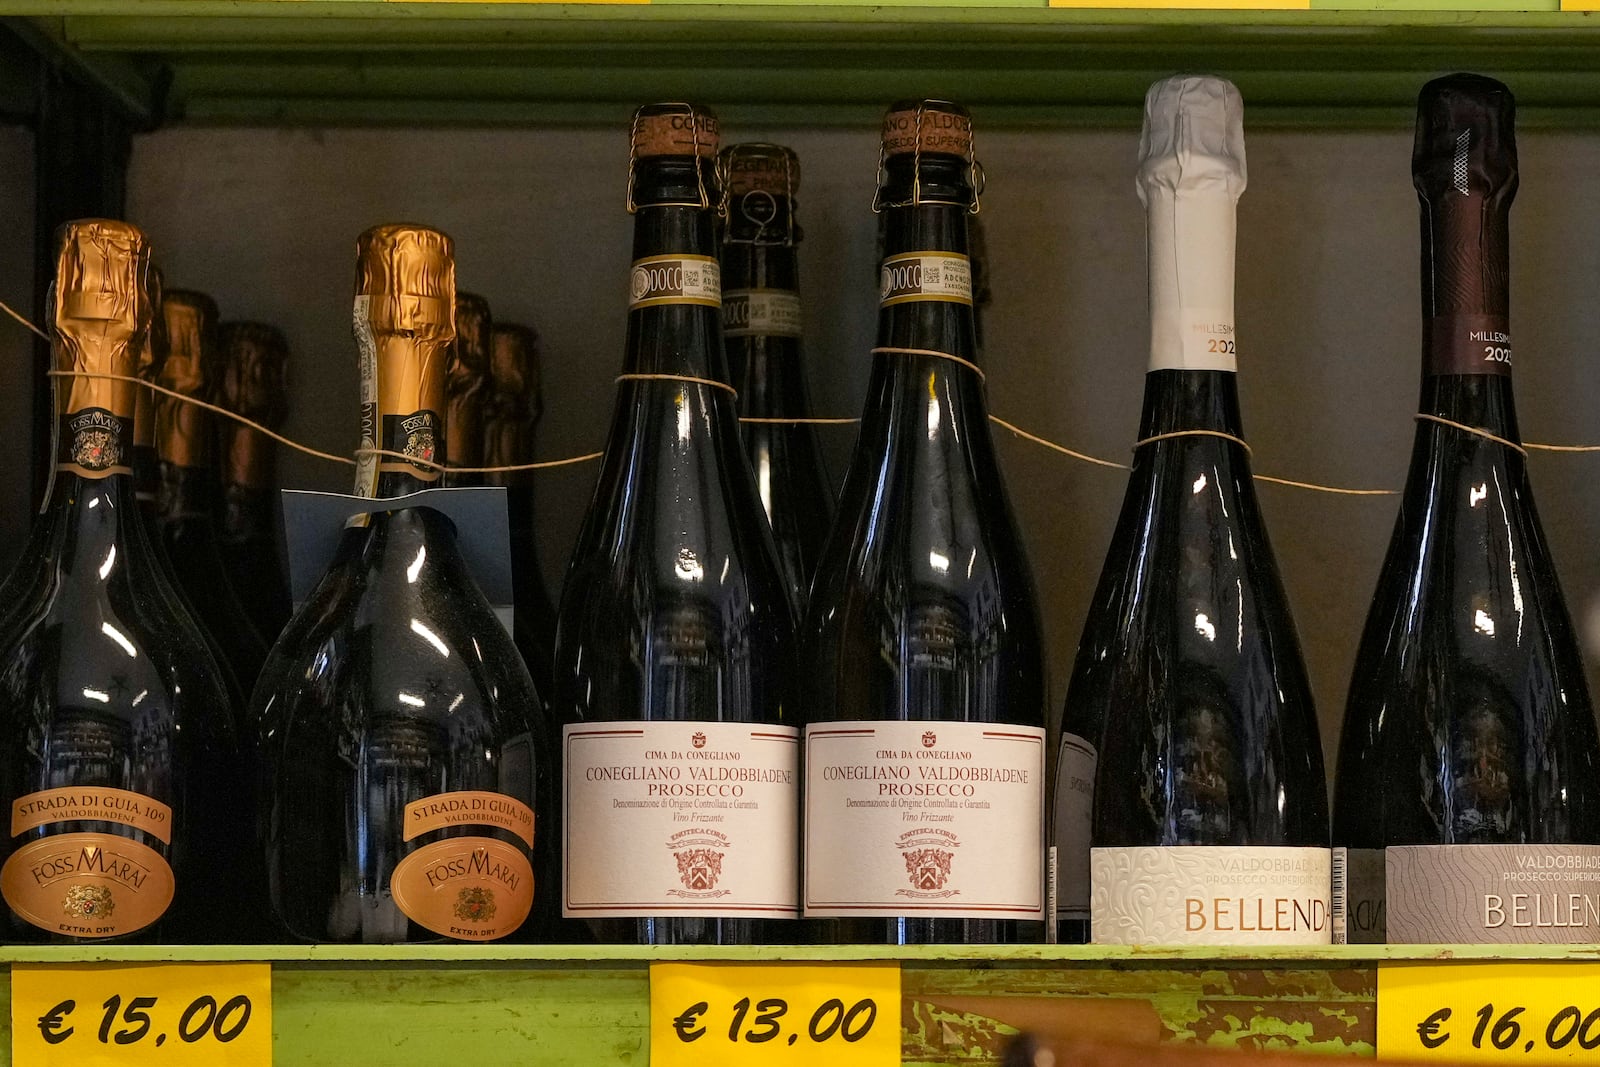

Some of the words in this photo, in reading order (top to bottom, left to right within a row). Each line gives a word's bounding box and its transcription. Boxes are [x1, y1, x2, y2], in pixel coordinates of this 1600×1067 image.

[651, 266, 682, 292] DOCG
[893, 264, 922, 291] DOCG
[645, 750, 668, 761] CIMA
[671, 751, 683, 761] DA
[686, 750, 741, 761] CONEGLIANO
[876, 750, 898, 760] CIMA
[901, 750, 913, 760] DA
[916, 750, 972, 760] CONEGLIANO
[586, 766, 680, 782] CONEGLIANO
[689, 766, 792, 785] VALDOBBIADENE
[823, 765, 911, 781] CONEGLIANO
[918, 766, 1029, 784] VALDOBBIADENE
[648, 783, 744, 798] PROSECCO
[878, 783, 975, 797] PROSECCO
[19, 796, 79, 817] STRADA
[82, 795, 99, 806] DI
[145, 806, 166, 823] 109
[613, 798, 660, 809] Denominazione
[660, 798, 668, 809] di
[668, 798, 693, 811] Origine
[693, 798, 728, 809] Controllata
[846, 798, 890, 809] Denominazione
[890, 798, 898, 809] di
[898, 798, 923, 811] Origine
[923, 798, 959, 809] Controllata
[51, 809, 136, 824] VALDOBBIADENE
[413, 799, 469, 821] STRADA
[472, 798, 486, 810] DI
[519, 810, 532, 826] 109
[673, 812, 690, 823] Vino
[691, 812, 725, 823] Frizzante
[902, 812, 919, 823] Vino
[920, 812, 954, 823] Frizzante
[445, 813, 513, 827] VALDOBBIADENE
[935, 828, 958, 841] CORSI
[1206, 874, 1268, 885] PROSECCO
[1503, 871, 1562, 882] PROSECCO
[1484, 894, 1600, 929] BELLEN
[59, 923, 92, 934] EXTRA
[96, 925, 116, 934] DRY
[449, 926, 478, 936] EXTRA
[481, 928, 497, 936] DRY
[37, 999, 76, 1044] €
[98, 994, 252, 1047] 15,00
[672, 1001, 709, 1043] €
[728, 997, 878, 1046] 13,00
[1416, 1007, 1452, 1049] €
